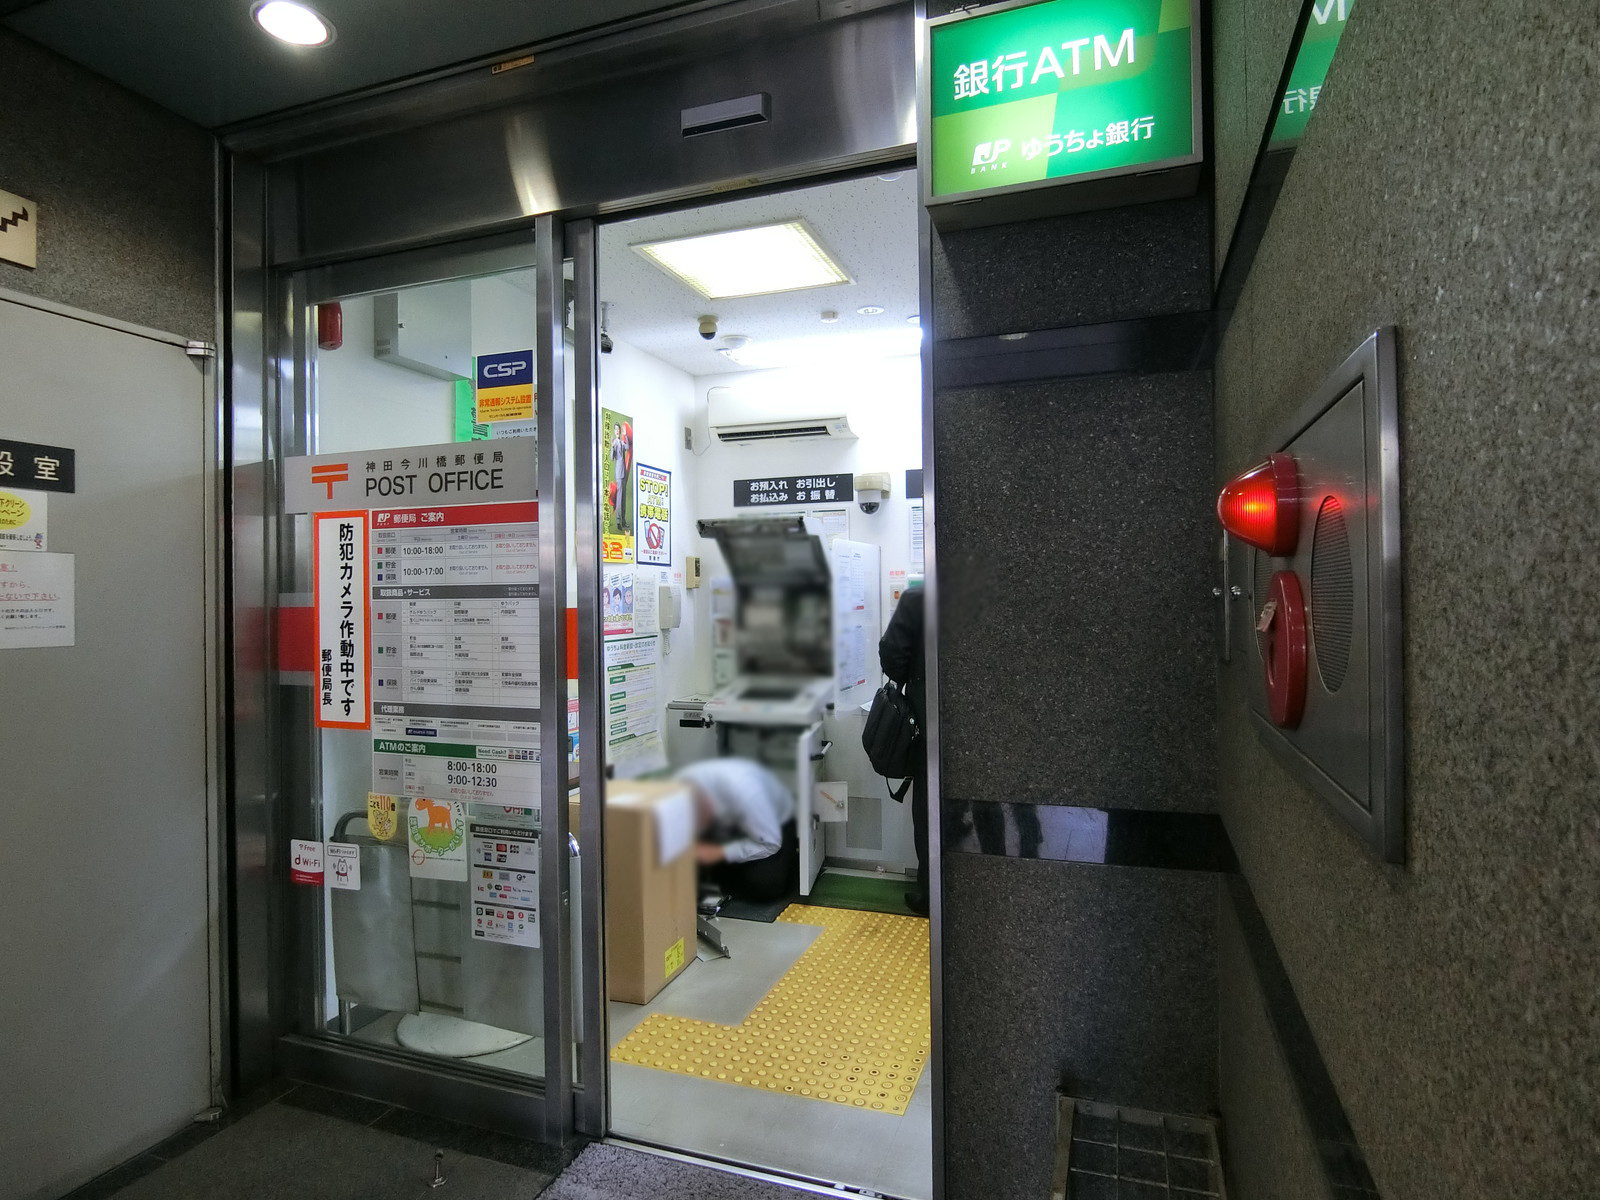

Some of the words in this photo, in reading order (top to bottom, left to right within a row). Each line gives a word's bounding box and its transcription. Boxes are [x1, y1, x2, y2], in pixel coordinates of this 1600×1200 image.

[953, 27, 1135, 100] 銀行ATM
[1021, 116, 1155, 161] ゆうちょ銀行
[971, 162, 1009, 175] BANK
[483, 360, 527, 379] CSP
[366, 451, 504, 473] 神田今川橋郵便局
[366, 474, 418, 497] POST
[428, 468, 504, 493] OFFICE
[639, 478, 669, 497] STOP!
[750, 481, 789, 491] お預入れ
[796, 478, 836, 489] お引出し
[750, 492, 789, 503] お払込み
[393, 513, 417, 524] 郵便局
[421, 511, 445, 523] ご案内
[403, 546, 444, 555] 10:00-18:00
[403, 567, 444, 575] 10:00-17:00
[339, 523, 355, 717] 防犯カメラ作動中です
[321, 649, 333, 706] 郵便局長
[379, 741, 426, 754] ATMのご案内
[447, 761, 497, 774] 8:00-18:00
[447, 774, 497, 788] 9:00-12:30
